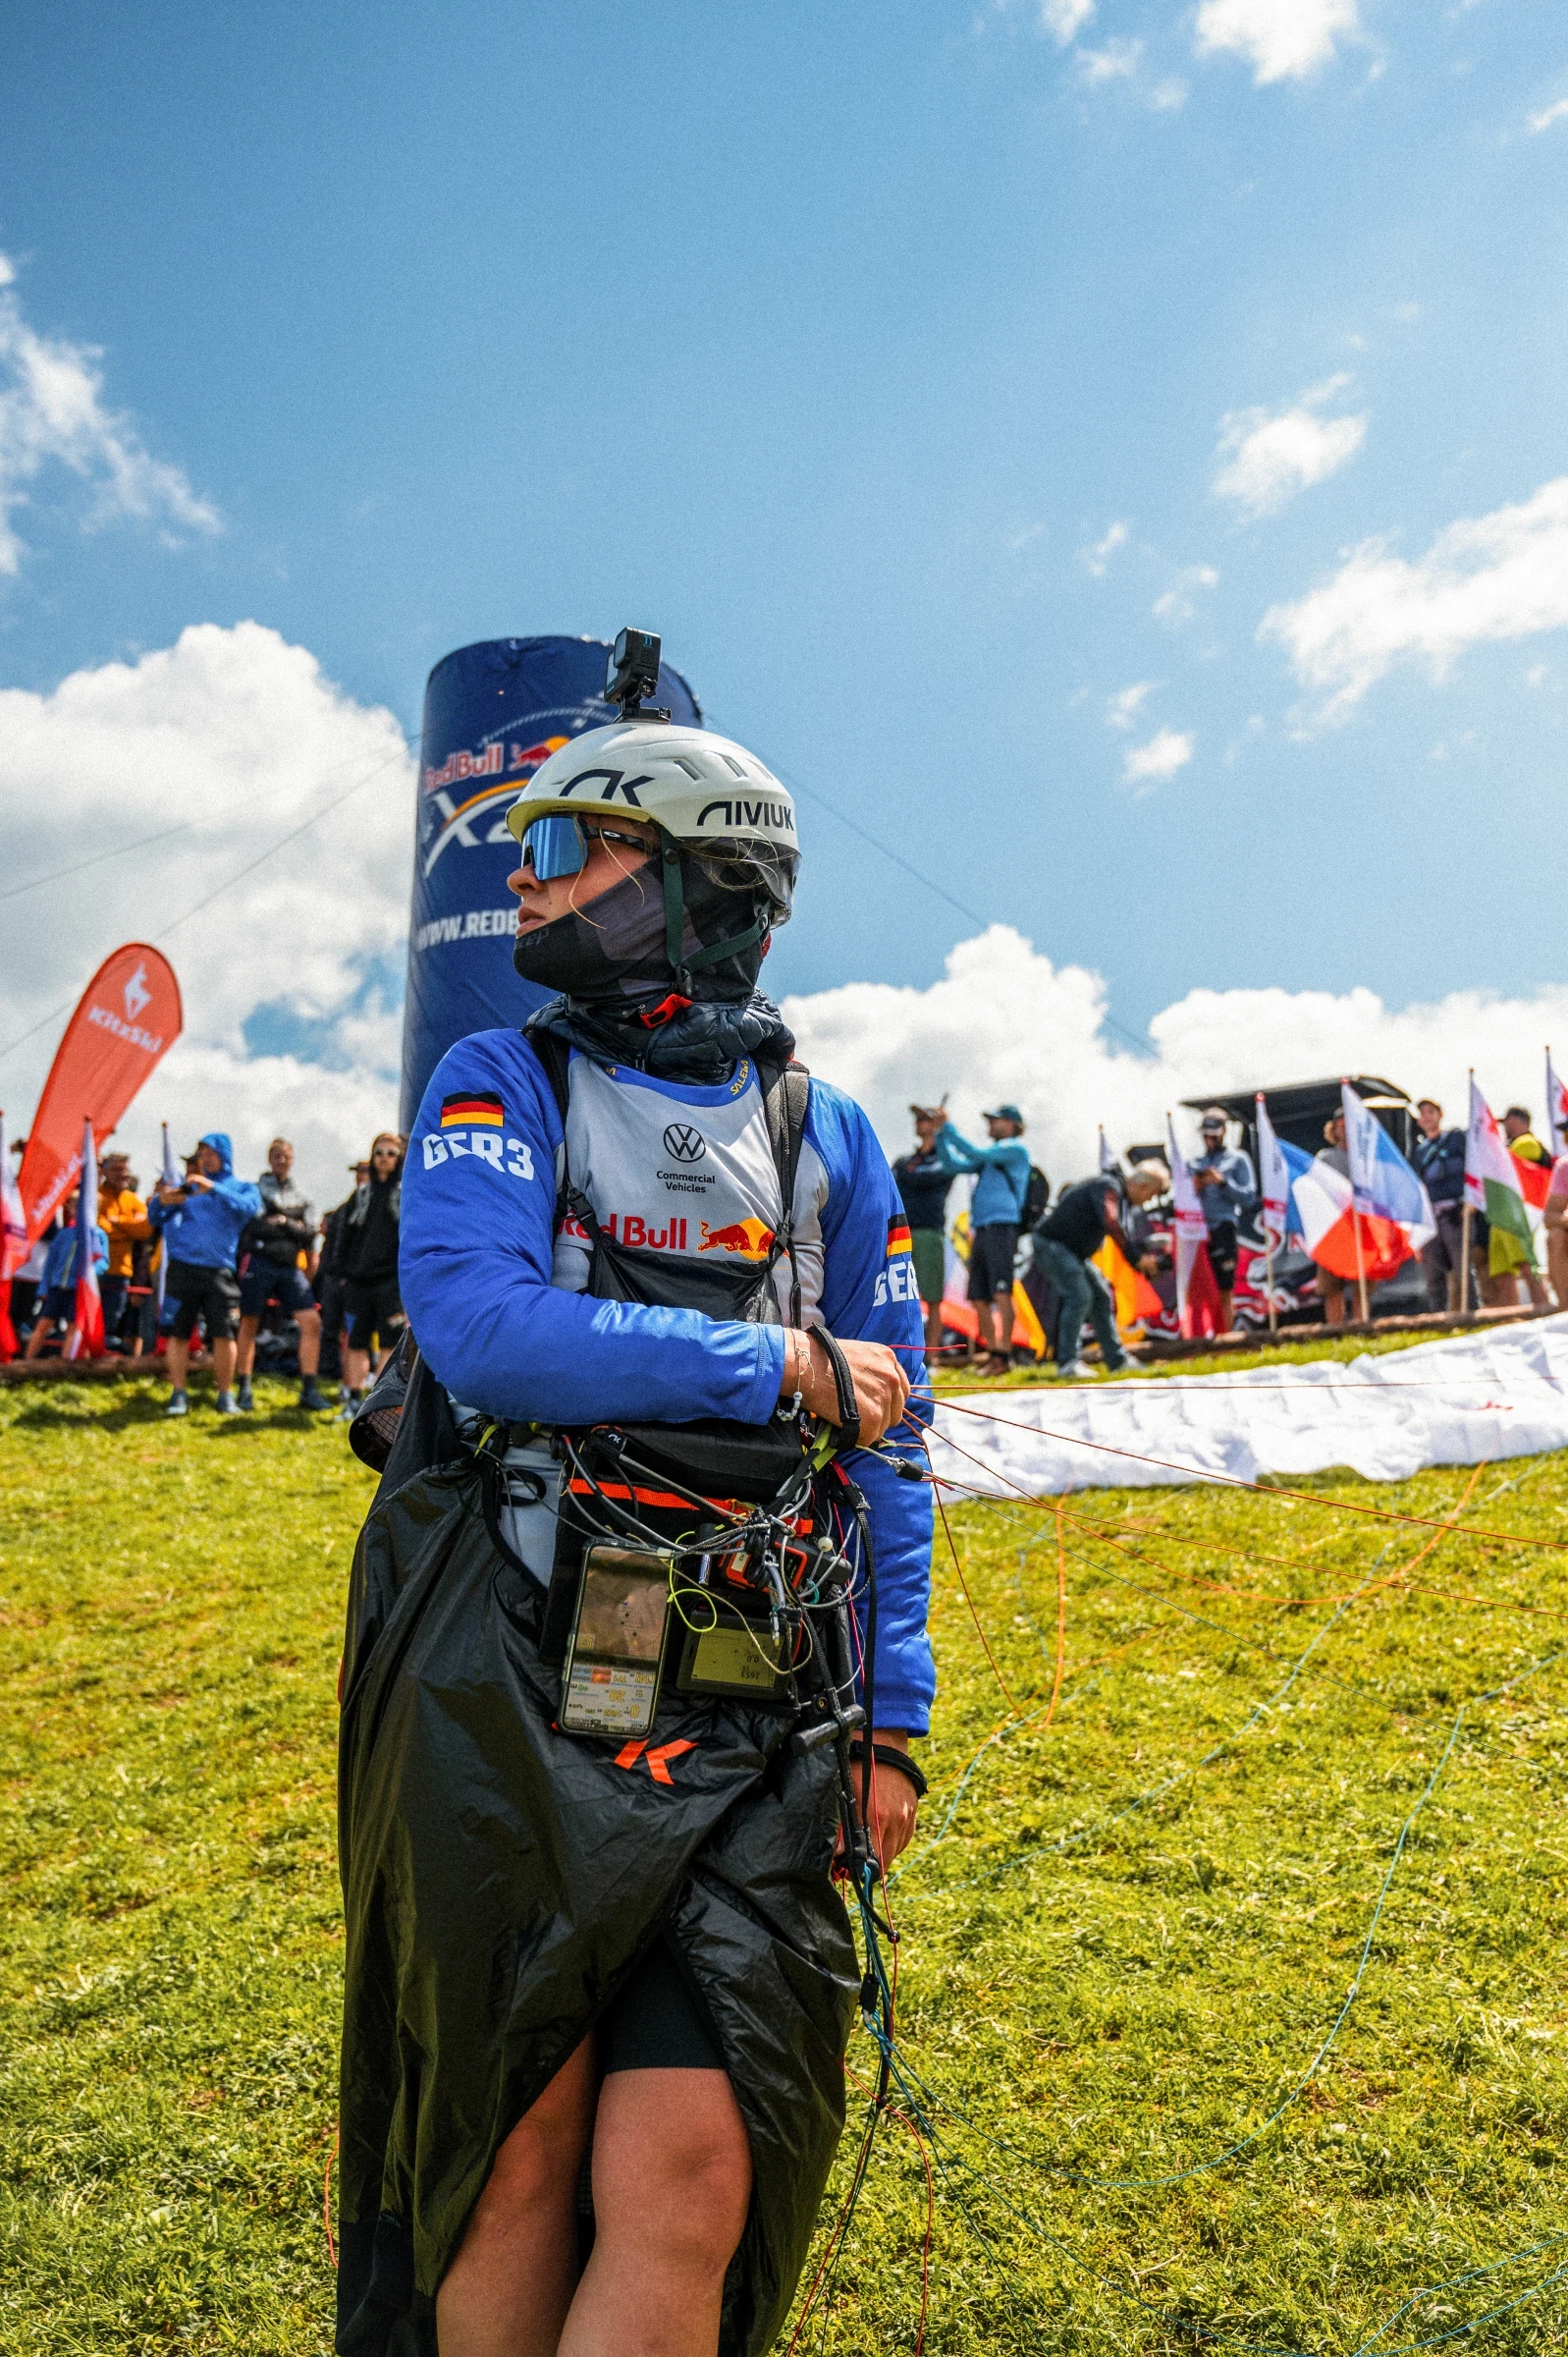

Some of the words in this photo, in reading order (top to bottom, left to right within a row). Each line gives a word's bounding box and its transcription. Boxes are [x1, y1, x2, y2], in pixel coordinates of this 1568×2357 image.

[456, 742, 504, 779] Bull
[730, 1060, 749, 1096] SALEWA
[656, 1170, 716, 1184] Commercial
[665, 1181, 707, 1193] Vehicles
[622, 1215, 687, 1250] Bull
